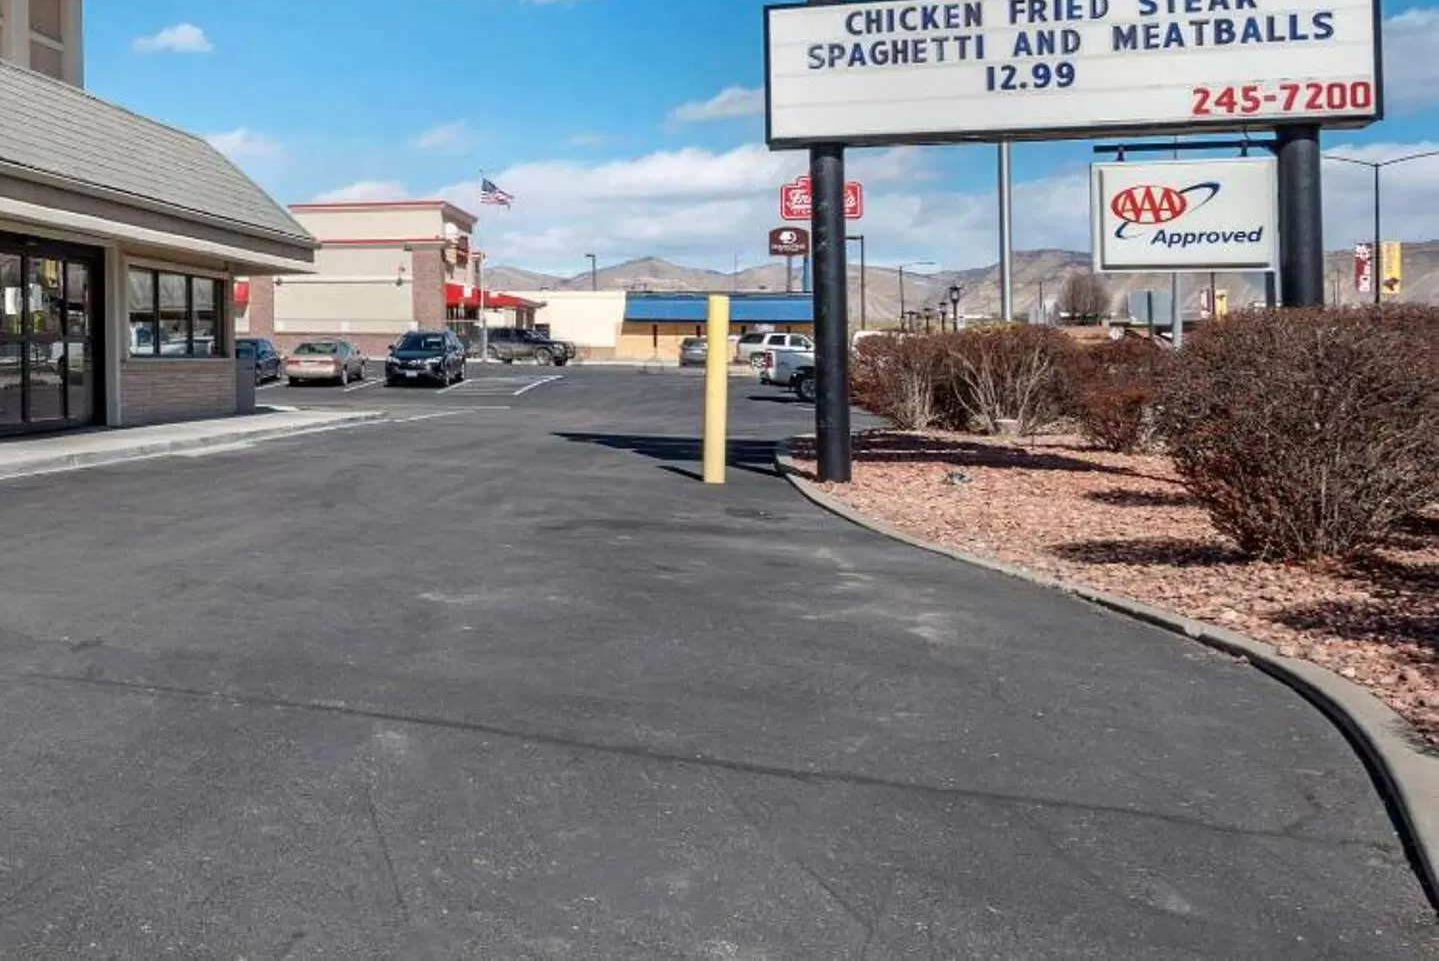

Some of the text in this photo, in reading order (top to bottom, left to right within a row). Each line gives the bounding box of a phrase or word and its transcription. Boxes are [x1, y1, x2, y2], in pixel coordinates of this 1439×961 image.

[845, 1, 983, 36] CHICKEN
[808, 12, 1334, 69] SPAGHETTI AND MEATBALLS
[986, 62, 1075, 91] 12.99
[1192, 81, 1371, 115] 245-7200
[1117, 185, 1181, 224] AAA
[1151, 226, 1264, 248] Approved
